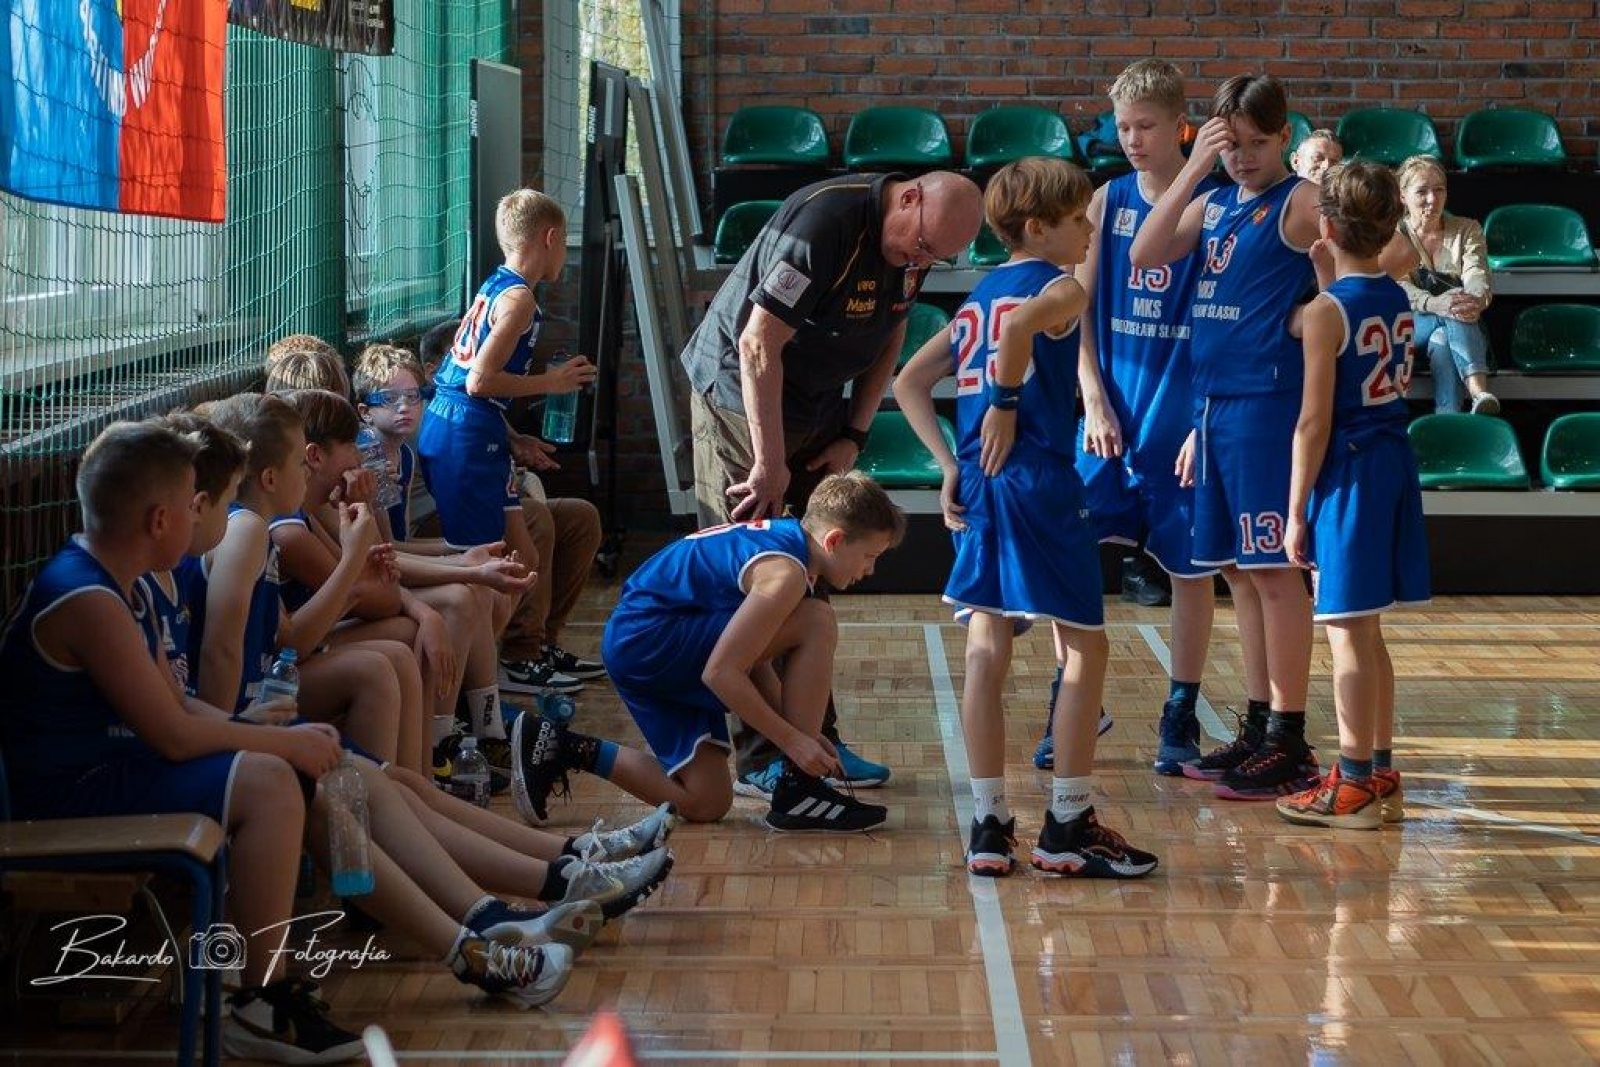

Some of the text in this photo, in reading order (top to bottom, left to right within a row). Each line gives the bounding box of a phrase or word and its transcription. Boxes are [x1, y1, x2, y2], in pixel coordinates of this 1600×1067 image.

[588, 104, 597, 143] DONIC
[1133, 297, 1162, 319] MKS
[1355, 311, 1415, 406] 23
[1239, 511, 1285, 554] 13
